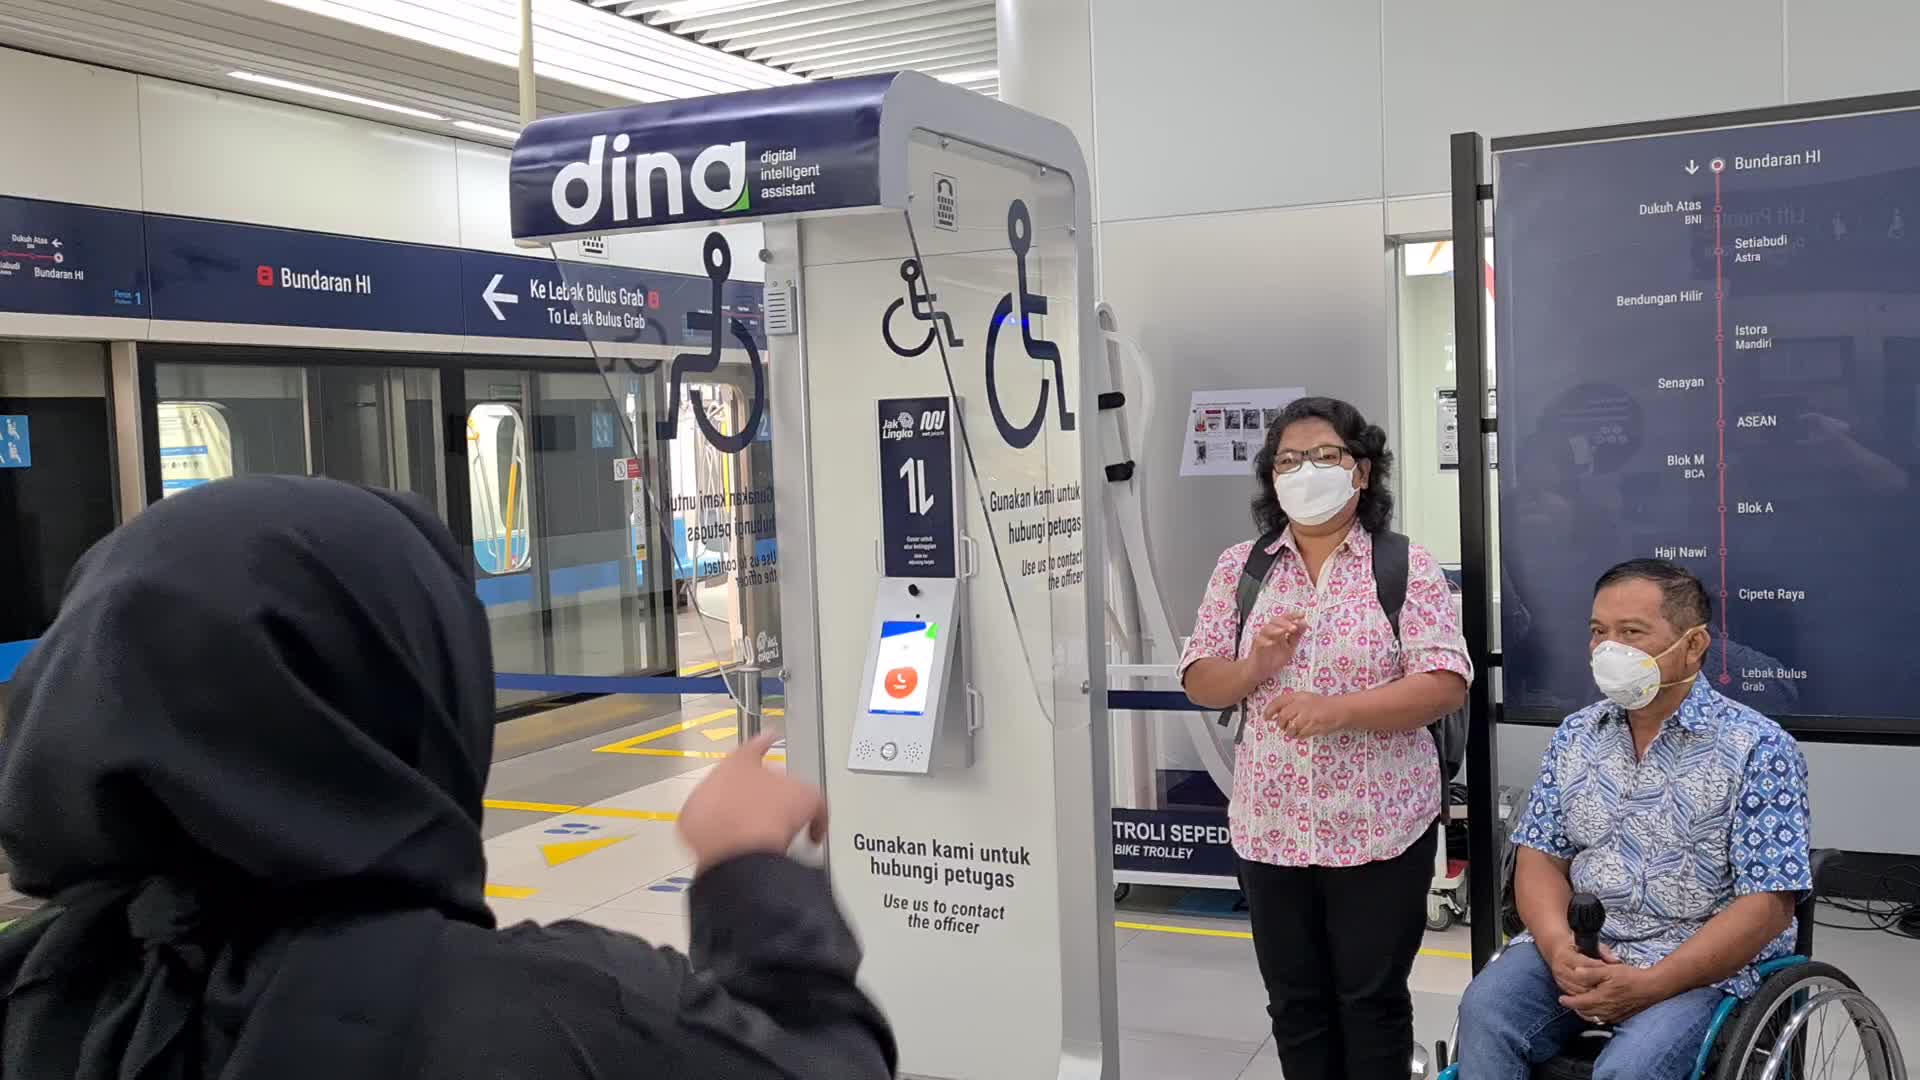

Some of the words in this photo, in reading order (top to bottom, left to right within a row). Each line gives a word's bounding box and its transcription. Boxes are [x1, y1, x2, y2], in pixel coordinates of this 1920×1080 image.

[760, 147, 796, 165] digital
[1735, 151, 1801, 170] Bundaran
[1806, 149, 1821, 164] HI
[551, 134, 747, 225] dina
[760, 164, 820, 182] intelligent
[761, 182, 815, 199] assistant
[1639, 202, 1674, 216] Dukuh
[1676, 200, 1702, 213] Atas
[1684, 214, 1702, 225] BNI
[1735, 235, 1787, 249] Setiabudi
[1735, 251, 1761, 263] Astra
[34, 267, 73, 280] Bundaran
[75, 270, 84, 280] HI
[280, 267, 352, 293] Bundaran
[356, 275, 371, 294] HI
[530, 279, 546, 299] Ke
[587, 284, 617, 305] Bulus
[619, 287, 644, 307] Grab
[1616, 292, 1678, 307] Bendungan
[1680, 290, 1703, 303] Hilir
[547, 308, 562, 324] To
[596, 311, 623, 328] Bulus
[624, 313, 645, 329] Grab
[1735, 324, 1768, 336] Istora
[1735, 338, 1772, 350] Mandiri
[1658, 377, 1705, 391] Senayan
[882, 419, 898, 429] Jak
[1736, 415, 1777, 428] ASEAN
[882, 427, 914, 441] Lingko
[1667, 454, 1691, 466] Blok
[1694, 454, 1705, 465] M
[1684, 468, 1705, 479] BCA
[990, 488, 1031, 512] Gunakan
[1034, 484, 1055, 506] kami
[1057, 480, 1080, 502] untuk
[1737, 502, 1762, 514] Blok
[1765, 502, 1774, 513] A
[1009, 517, 1045, 544] hubungi
[1048, 515, 1081, 538] petugas
[1655, 546, 1677, 561] Haji
[1679, 546, 1707, 559] Nawi
[1022, 559, 1036, 576] Use
[1038, 559, 1046, 573] us
[1049, 556, 1055, 570] to
[1057, 550, 1082, 568] contact
[1049, 574, 1059, 590] the
[1061, 569, 1083, 588] officer
[1738, 588, 1776, 603] Cipete
[1778, 588, 1805, 601] Raya
[1742, 667, 1774, 679] Lebak
[1777, 668, 1807, 680] Bulus
[1742, 681, 1765, 692] Grab
[1112, 821, 1165, 841] TROLI
[854, 833, 927, 857] Gunakan
[932, 839, 974, 860] kami
[980, 846, 1031, 866] untuk
[1114, 844, 1140, 856] BIKE
[1143, 845, 1193, 860] TROLLEY
[870, 856, 939, 884] hubungi
[944, 866, 1015, 891] petugas
[883, 893, 909, 910] Use
[913, 899, 929, 912] us
[934, 900, 947, 914] to
[951, 903, 1005, 920] contact
[908, 913, 930, 929] the
[934, 916, 980, 934] officer
